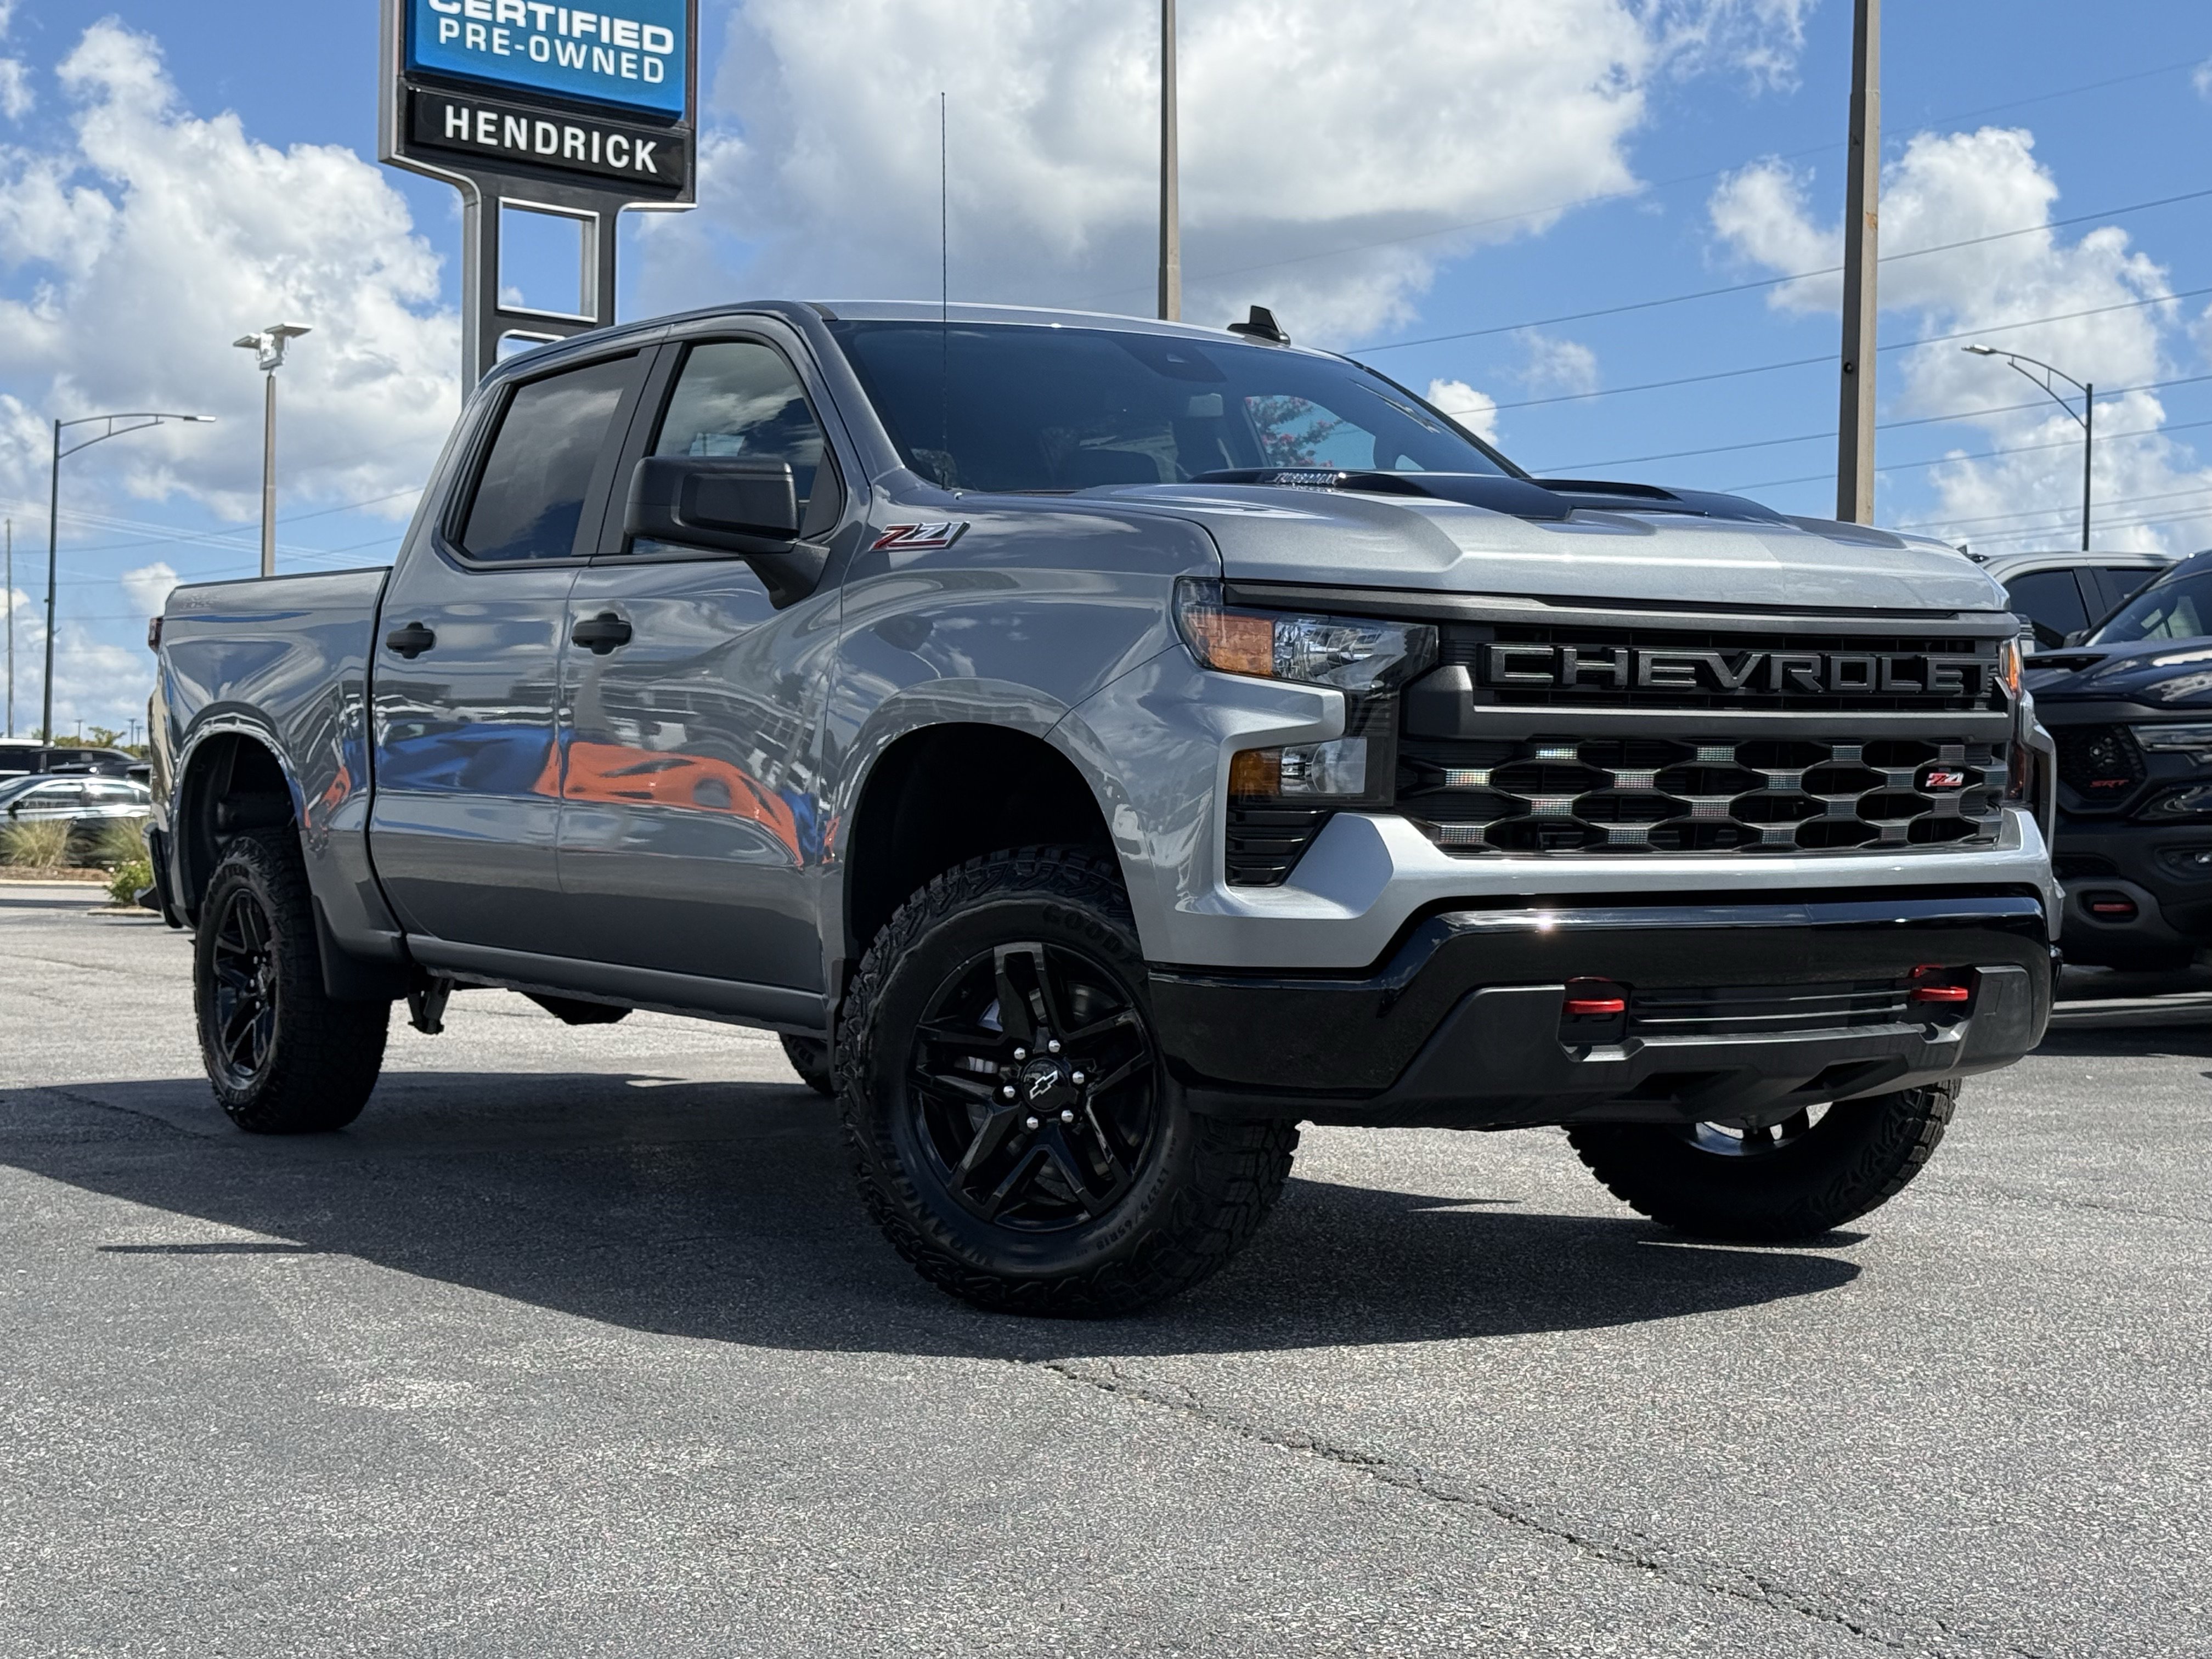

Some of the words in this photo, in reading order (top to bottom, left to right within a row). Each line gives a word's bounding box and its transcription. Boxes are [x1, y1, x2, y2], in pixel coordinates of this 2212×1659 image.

[428, 0, 674, 55] CERTIFIED
[439, 19, 664, 84] PRE-OWNED
[444, 105, 657, 173] HENDRICK
[868, 521, 970, 550] Z71
[1489, 645, 2000, 693] CHEVROLET
